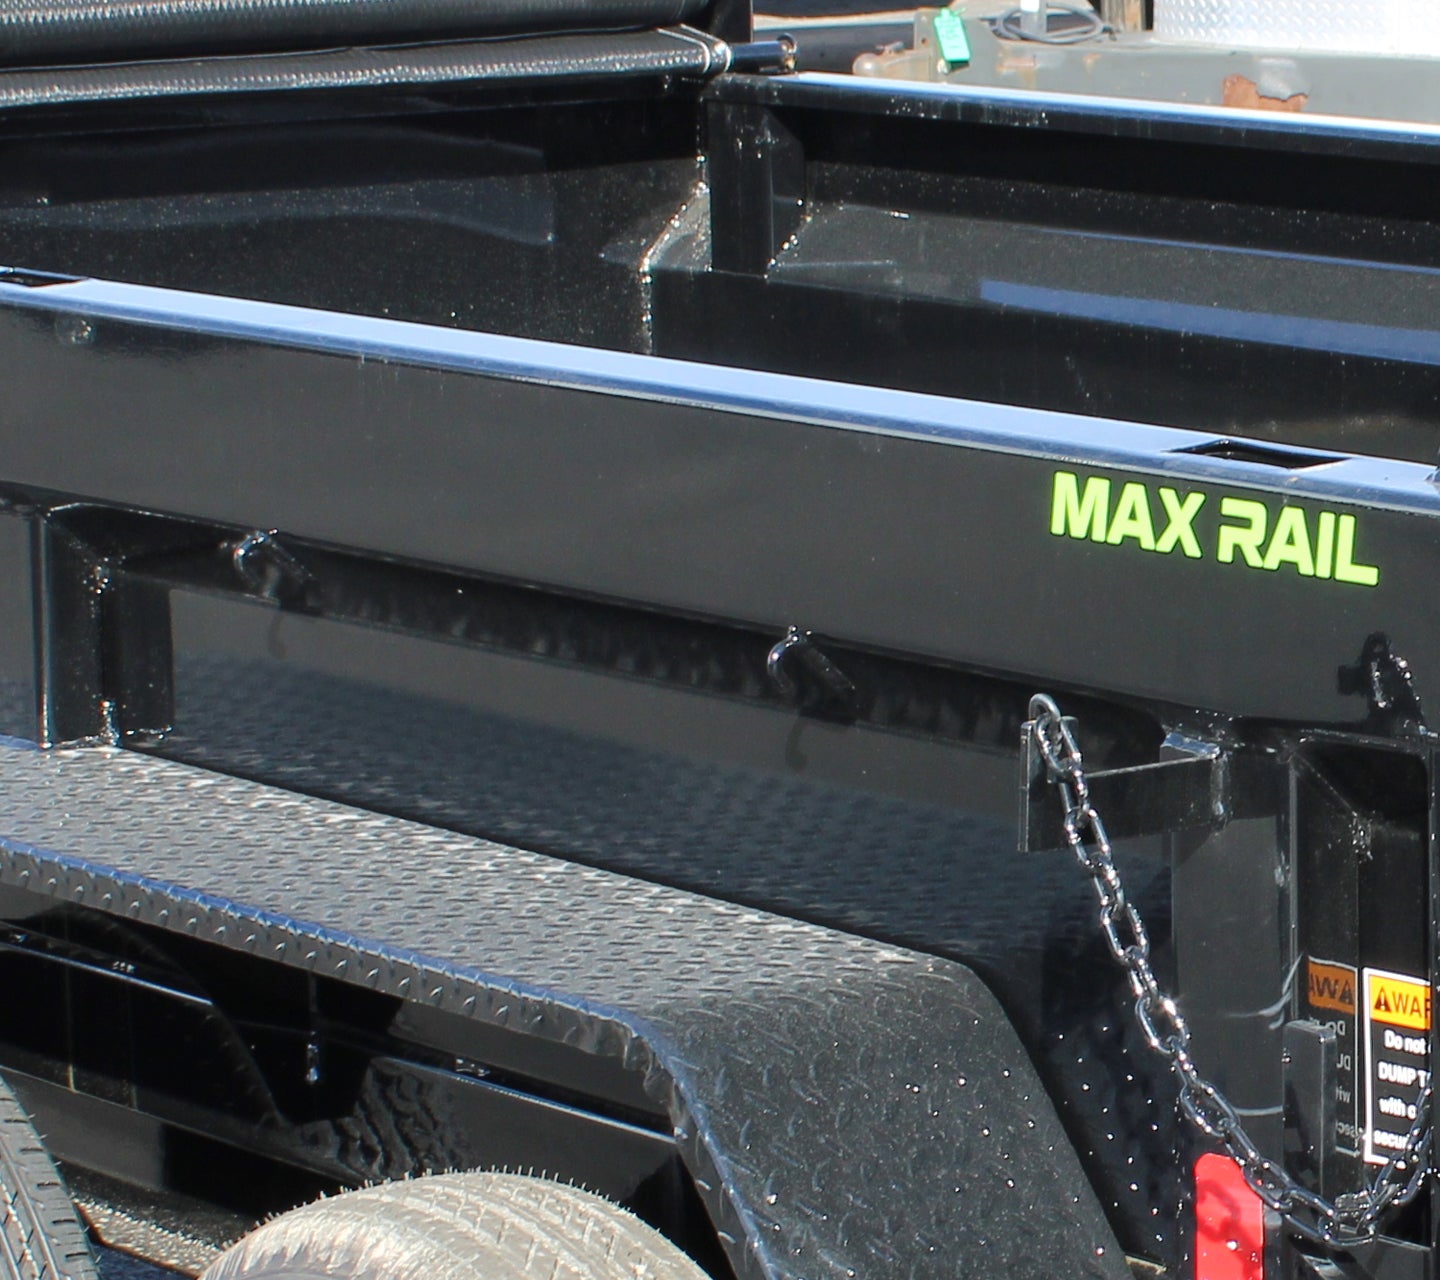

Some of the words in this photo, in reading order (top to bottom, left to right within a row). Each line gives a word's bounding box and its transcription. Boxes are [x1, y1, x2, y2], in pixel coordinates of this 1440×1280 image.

[1050, 470, 1207, 560] MAX
[1216, 495, 1381, 587] RAIL
[1383, 1029, 1404, 1051] Do
[1404, 1033, 1427, 1056] not
[1377, 1061, 1417, 1087] DUMP
[1378, 1096, 1407, 1119] with
